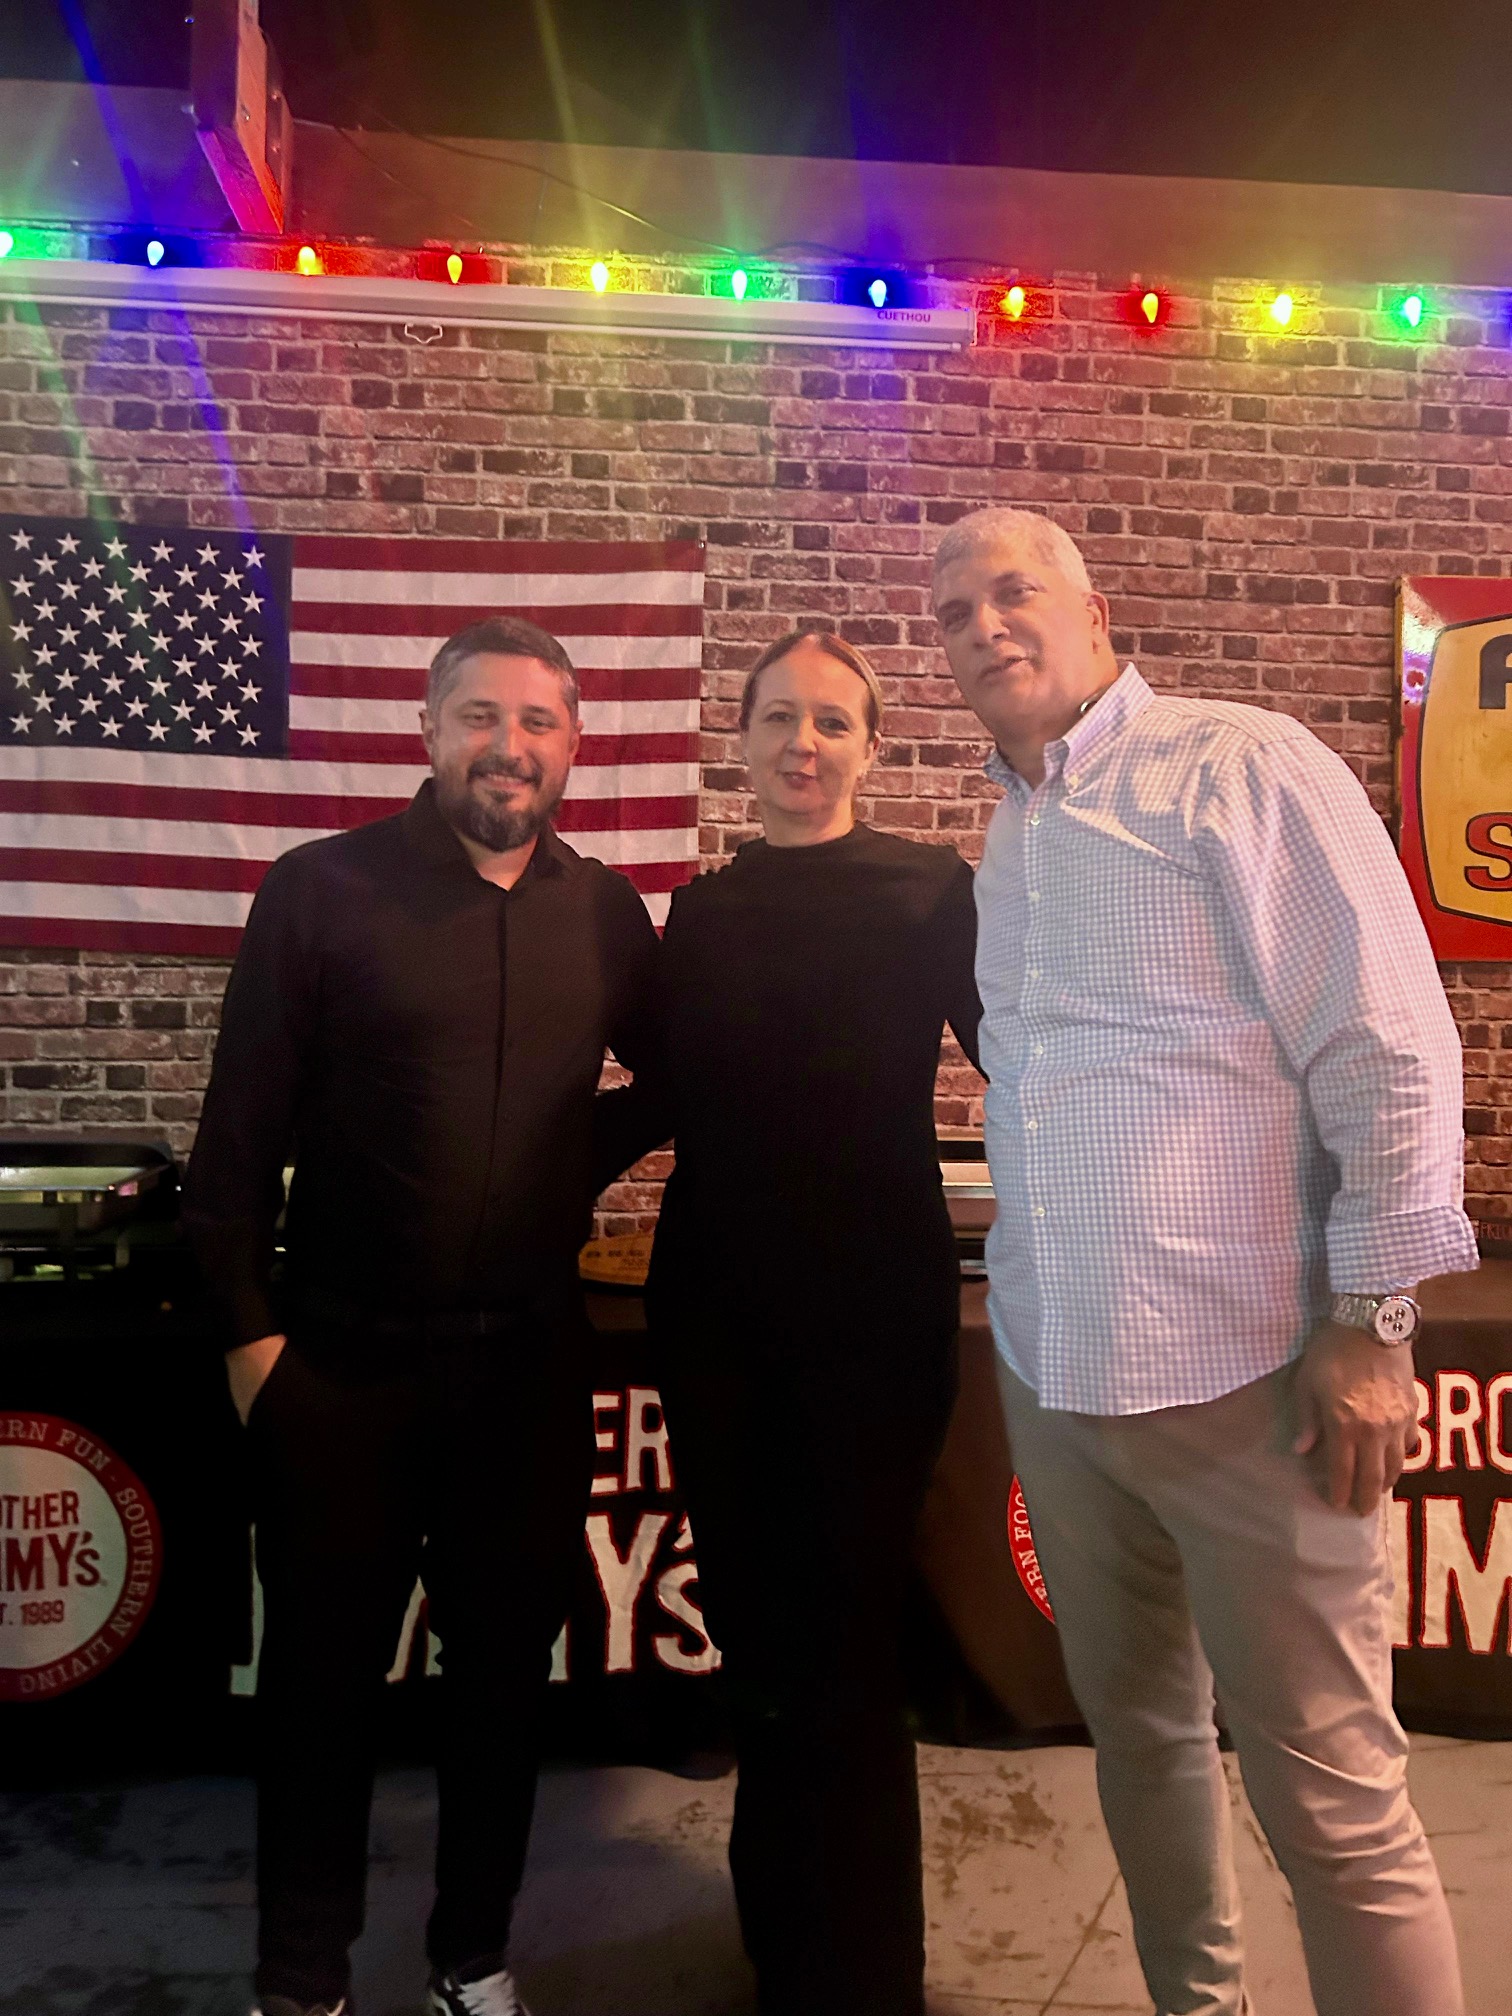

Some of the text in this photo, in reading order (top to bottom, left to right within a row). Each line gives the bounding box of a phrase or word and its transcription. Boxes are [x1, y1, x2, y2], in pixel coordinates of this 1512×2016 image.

[0, 1490, 79, 1530] THER
[0, 1418, 154, 1693] RN FUN SOUTHERN LIVING
